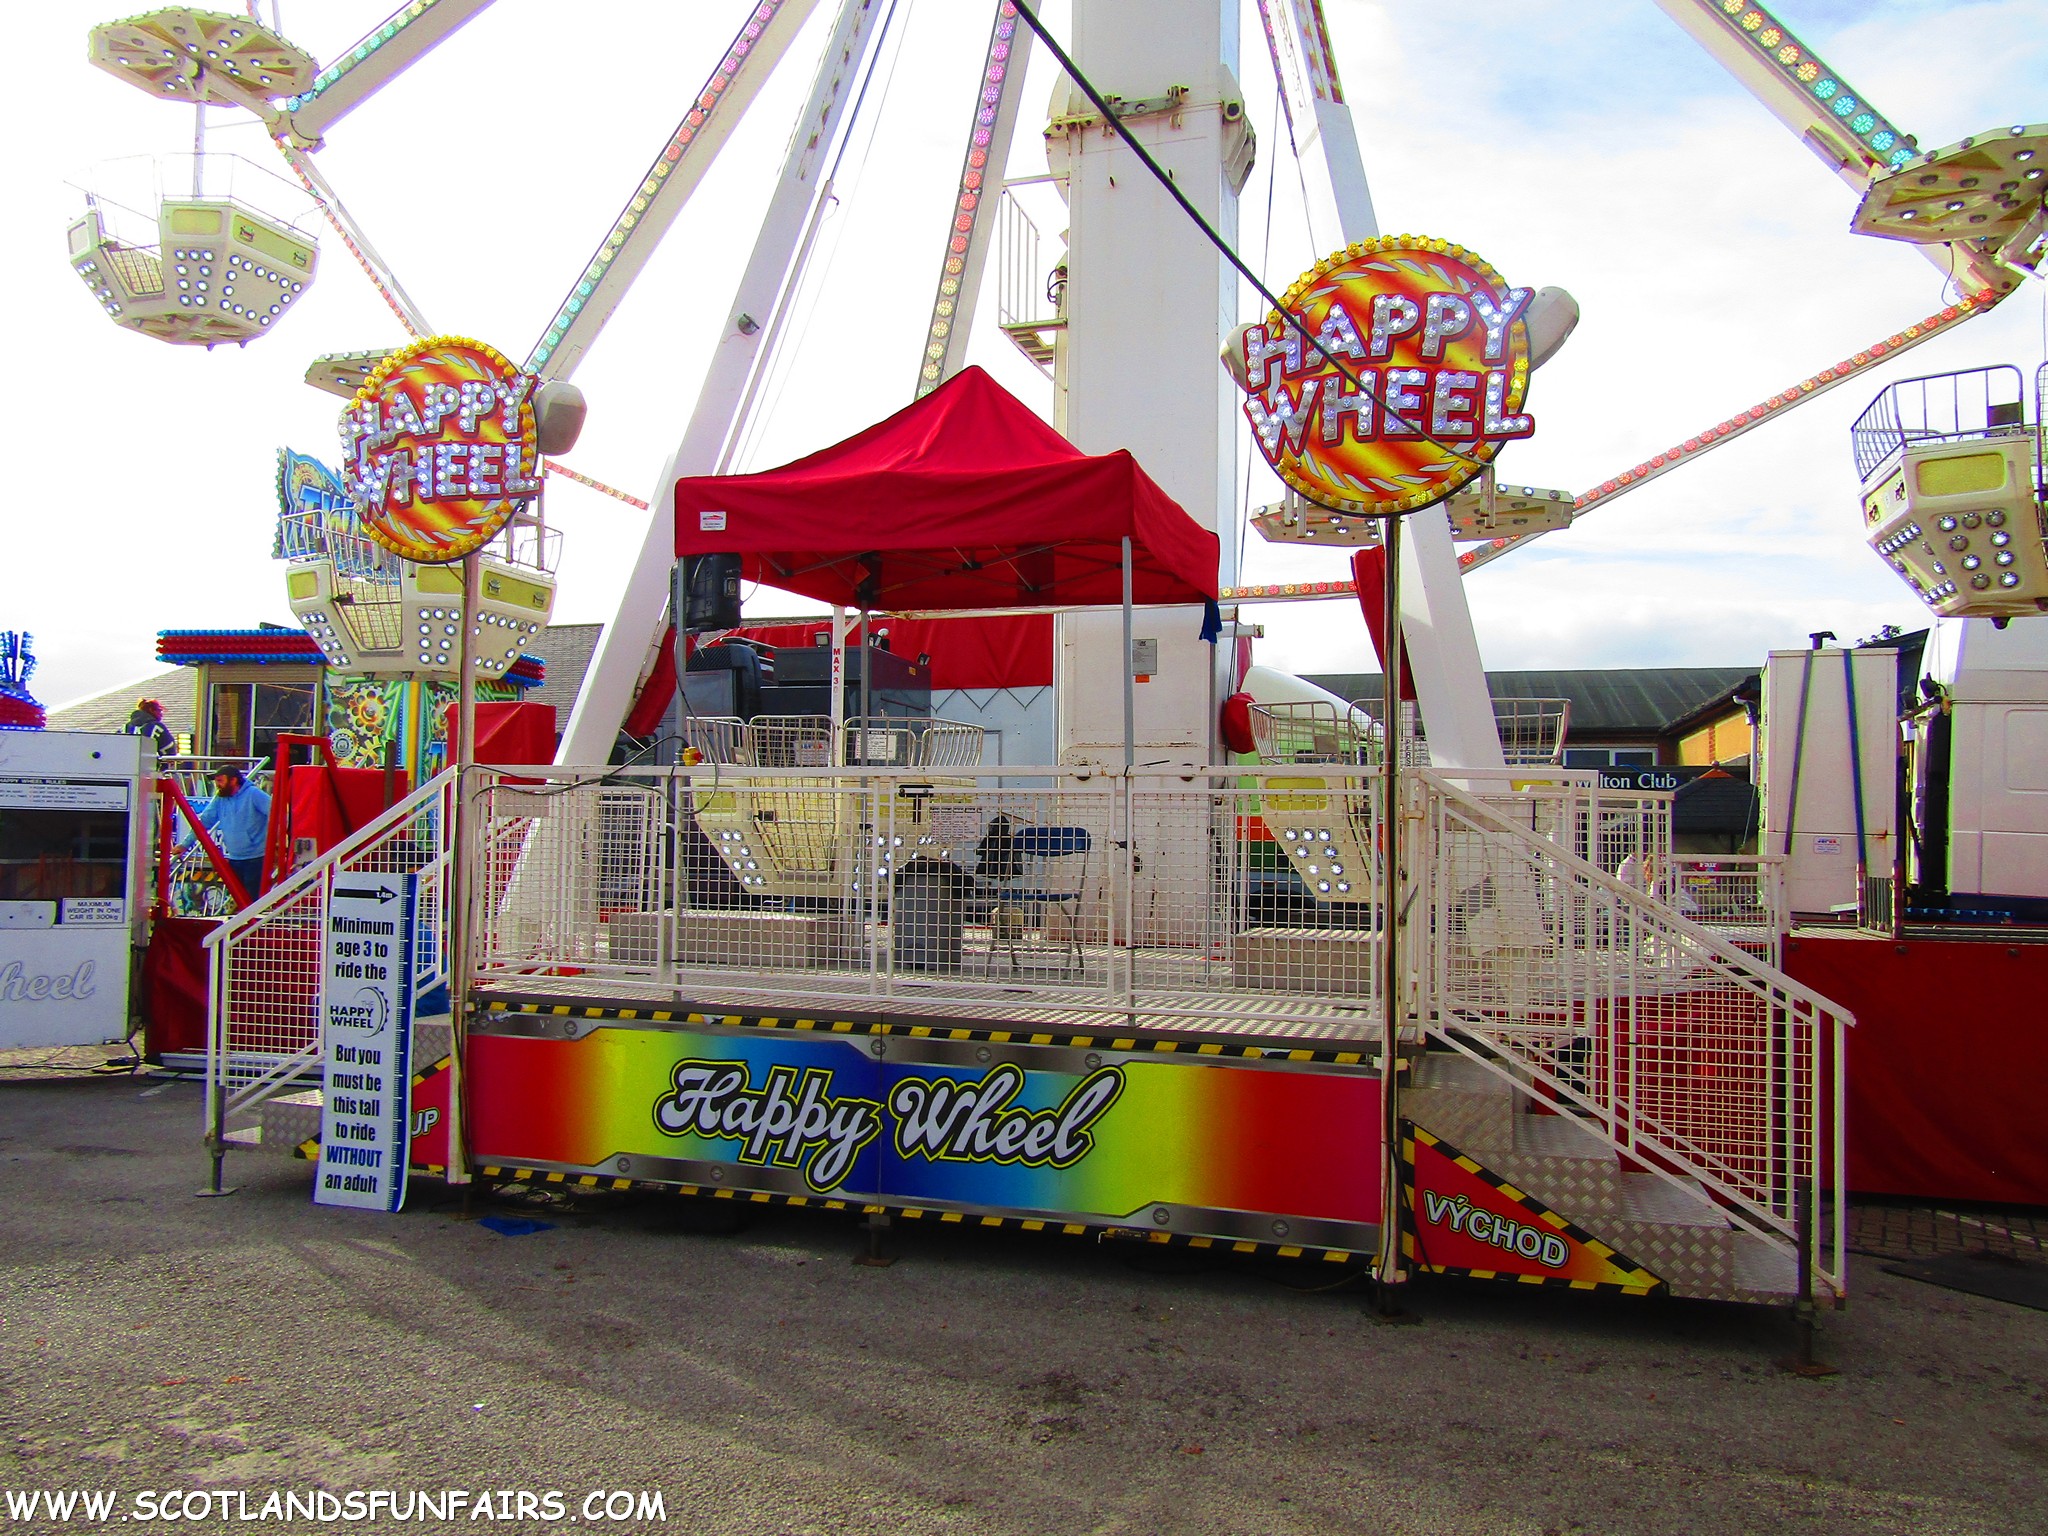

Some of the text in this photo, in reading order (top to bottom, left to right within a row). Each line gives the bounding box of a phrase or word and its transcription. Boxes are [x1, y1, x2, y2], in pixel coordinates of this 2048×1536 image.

[1245, 287, 1534, 389] HAPPY
[338, 376, 537, 459] HAPPY
[1245, 369, 1533, 460] WHEEL
[342, 445, 541, 520] WHEEL
[1576, 773, 1677, 788] Wlton Club
[332, 916, 394, 935] Minimum
[336, 941, 388, 958] age 3 to
[335, 961, 387, 980] ride the
[330, 1005, 374, 1017] HAPPY
[330, 1016, 374, 1028] WHEEL
[336, 1044, 381, 1065] But you
[333, 1073, 382, 1091] must be
[334, 1096, 380, 1116] this tall
[336, 1121, 376, 1141] to ride
[657, 1063, 1122, 1187] Happy Wheel
[327, 1145, 382, 1168] WITHOUT
[325, 1173, 378, 1194] an adult
[1425, 1190, 1568, 1267] VÝCHOD
